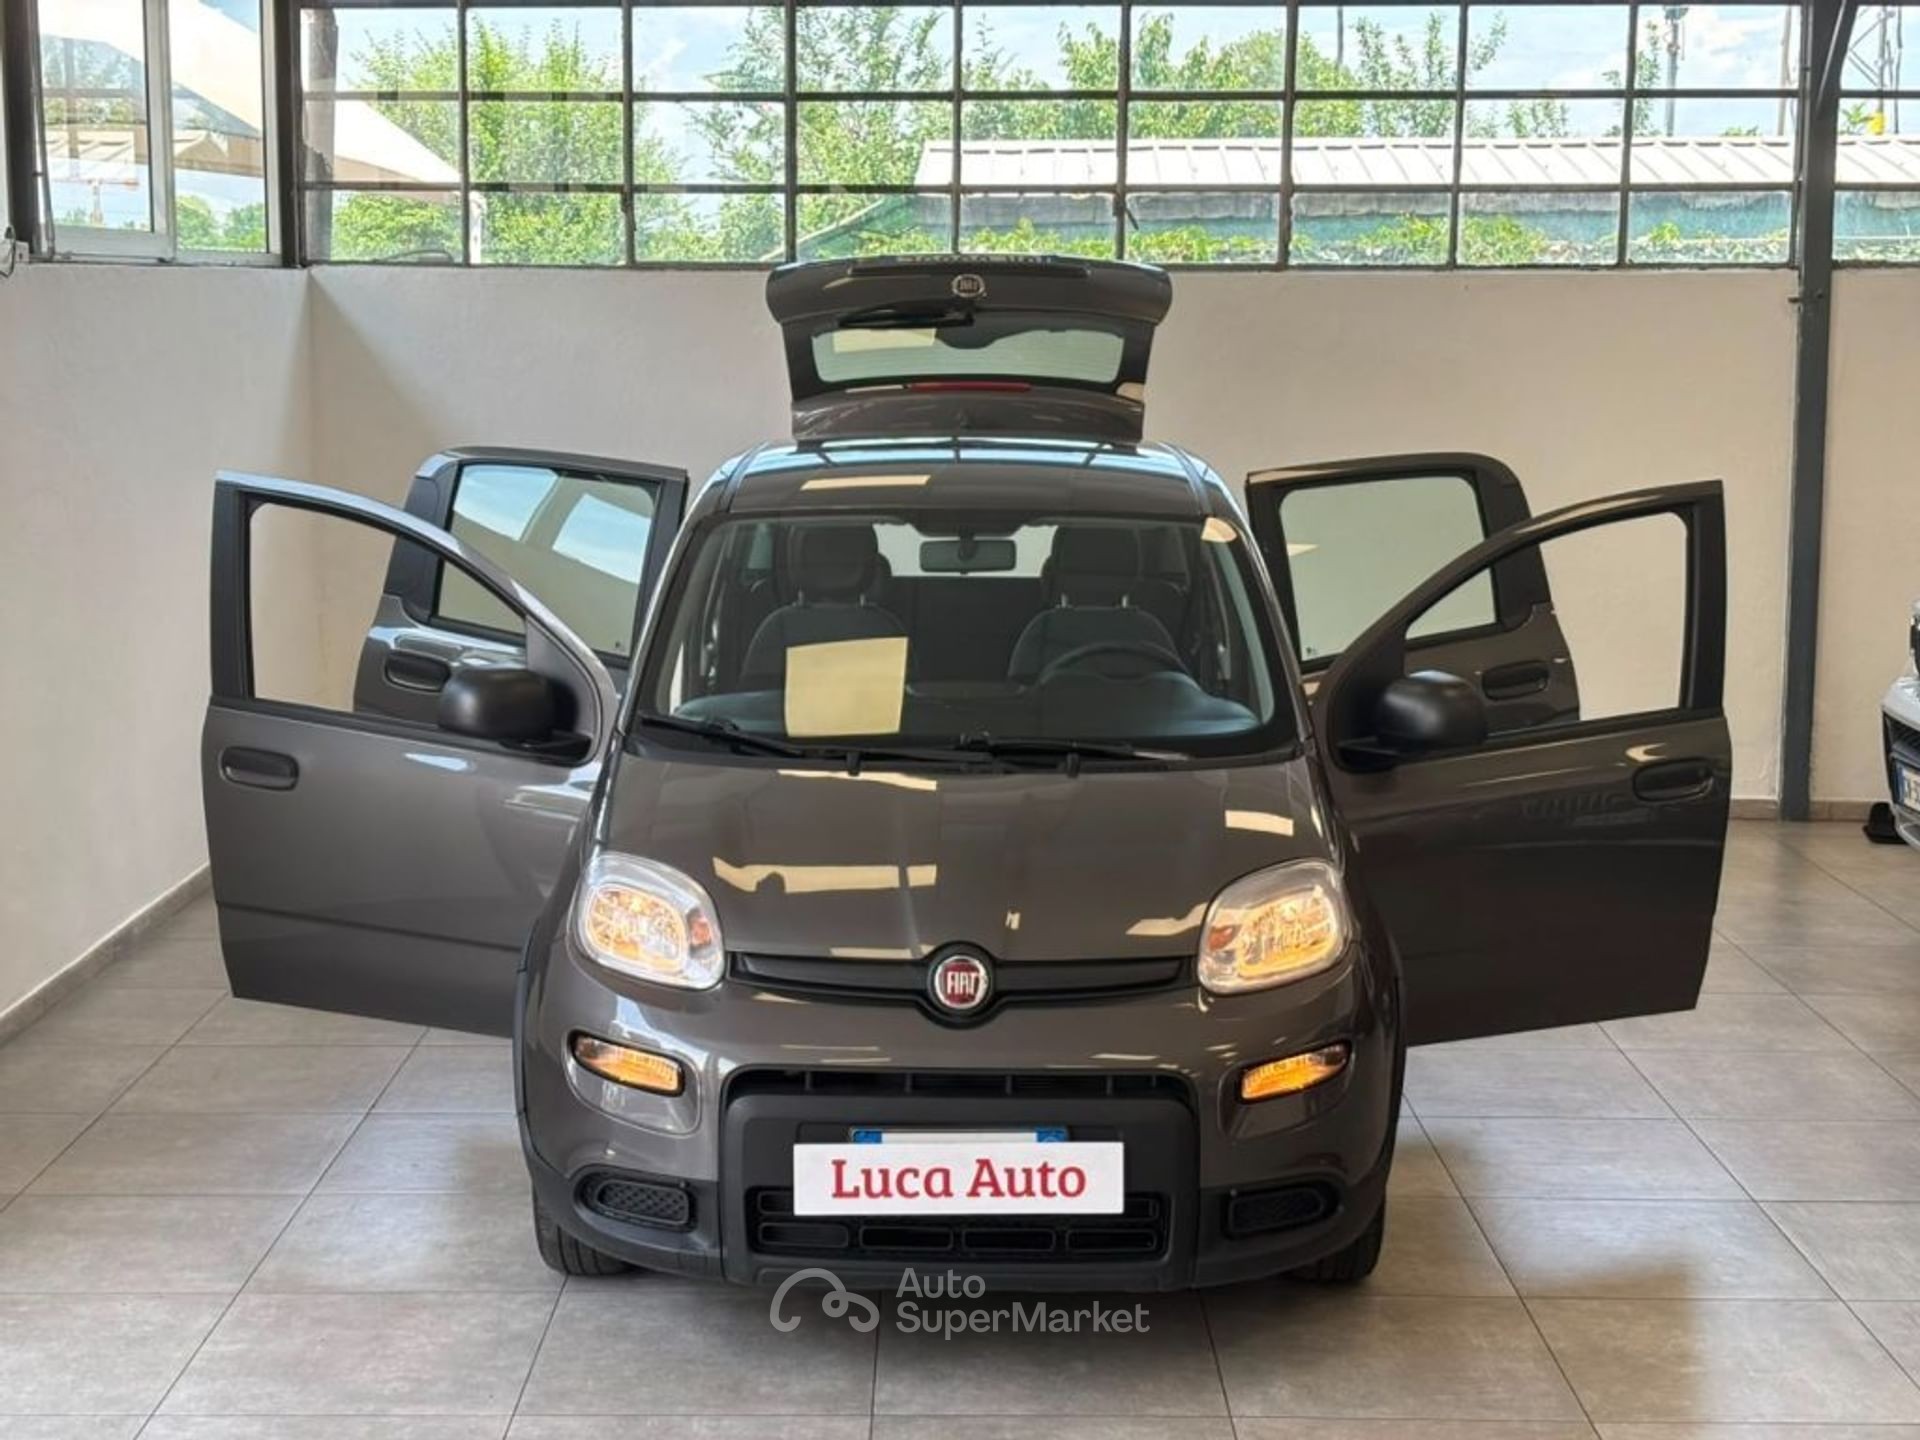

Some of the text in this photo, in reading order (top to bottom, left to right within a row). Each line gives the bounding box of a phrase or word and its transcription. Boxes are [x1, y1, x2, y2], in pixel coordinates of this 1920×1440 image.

[946, 970, 979, 996] FIAT
[831, 1158, 1087, 1199] Luca Auto
